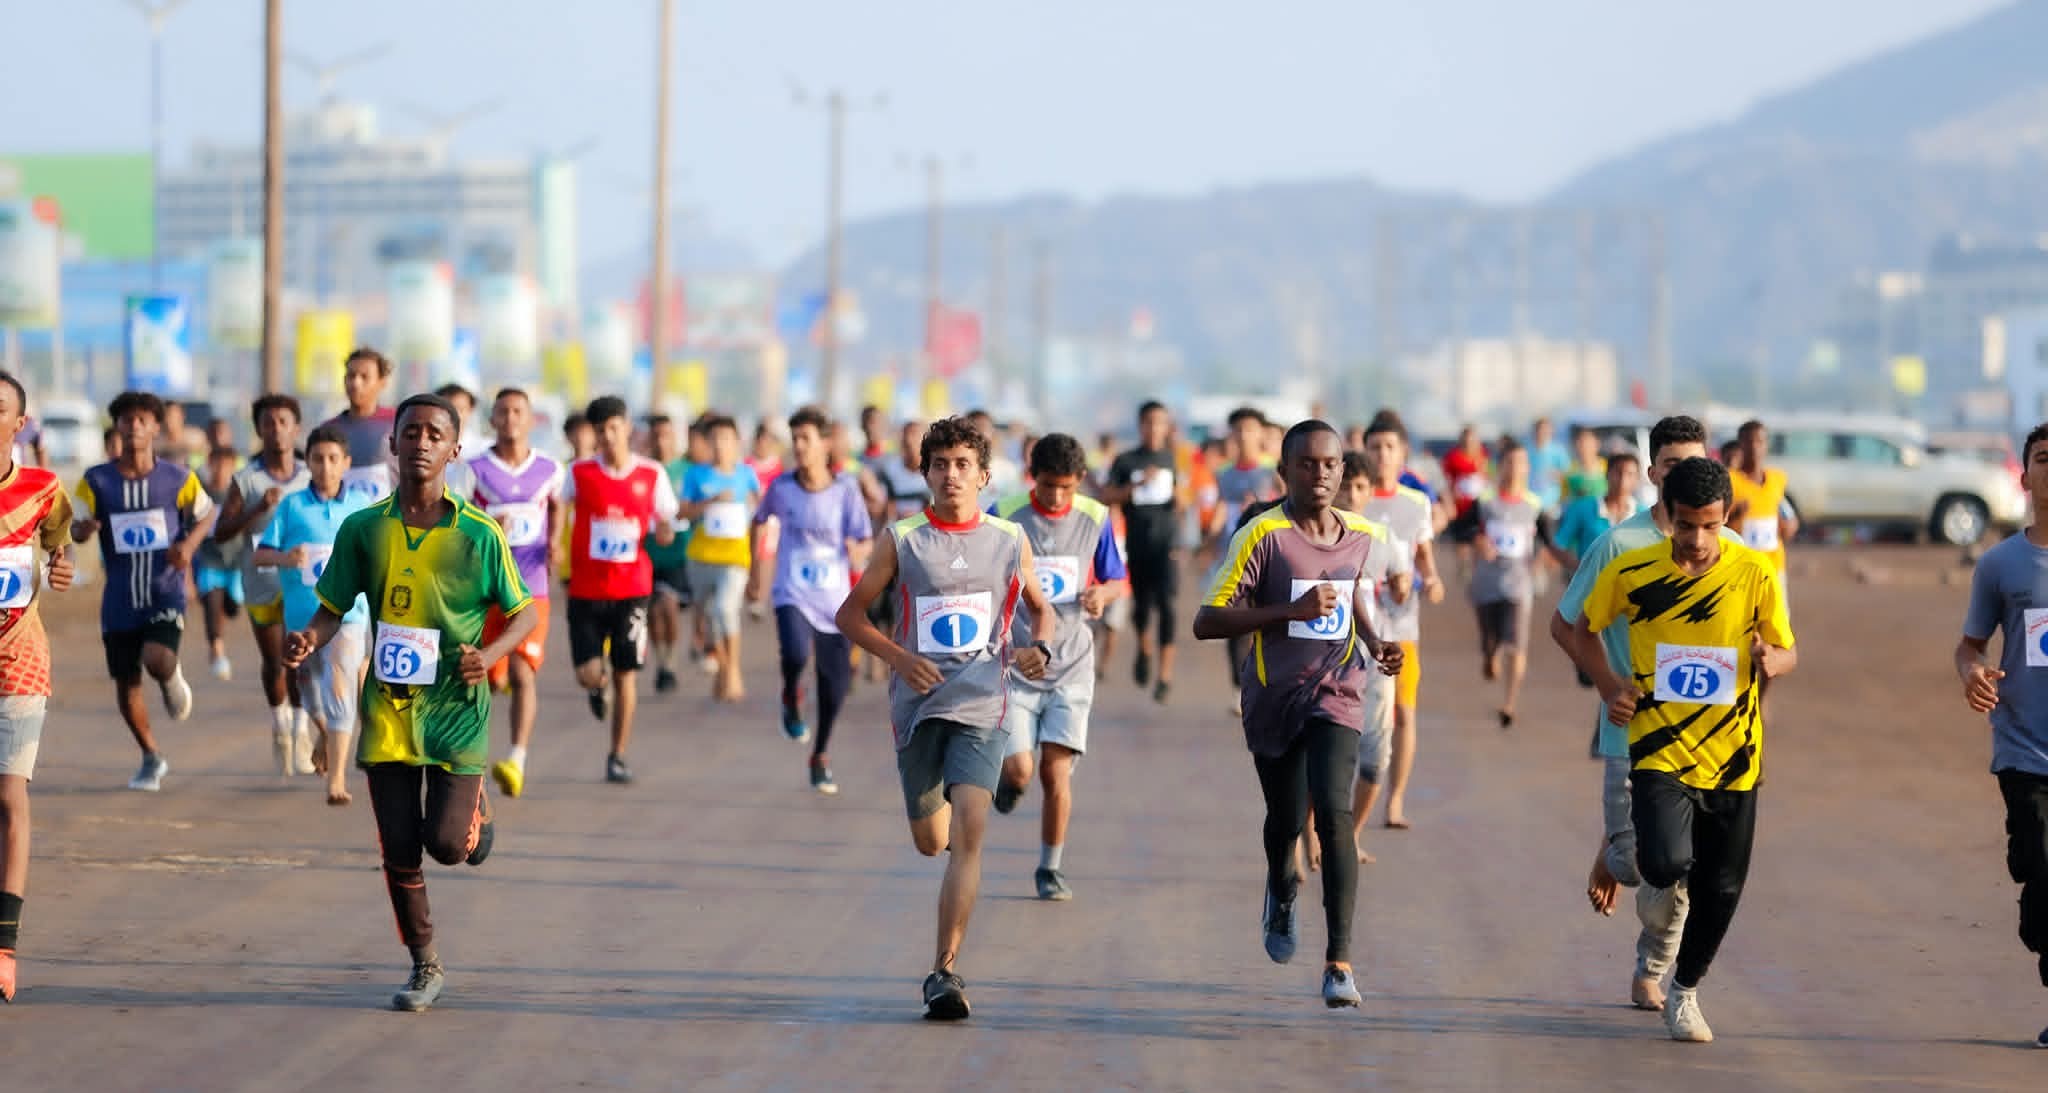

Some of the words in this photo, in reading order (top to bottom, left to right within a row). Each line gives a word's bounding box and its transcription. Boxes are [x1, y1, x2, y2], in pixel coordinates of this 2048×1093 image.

[948, 614, 961, 647] 1
[383, 645, 412, 677] 56
[1680, 665, 1709, 697] 75
